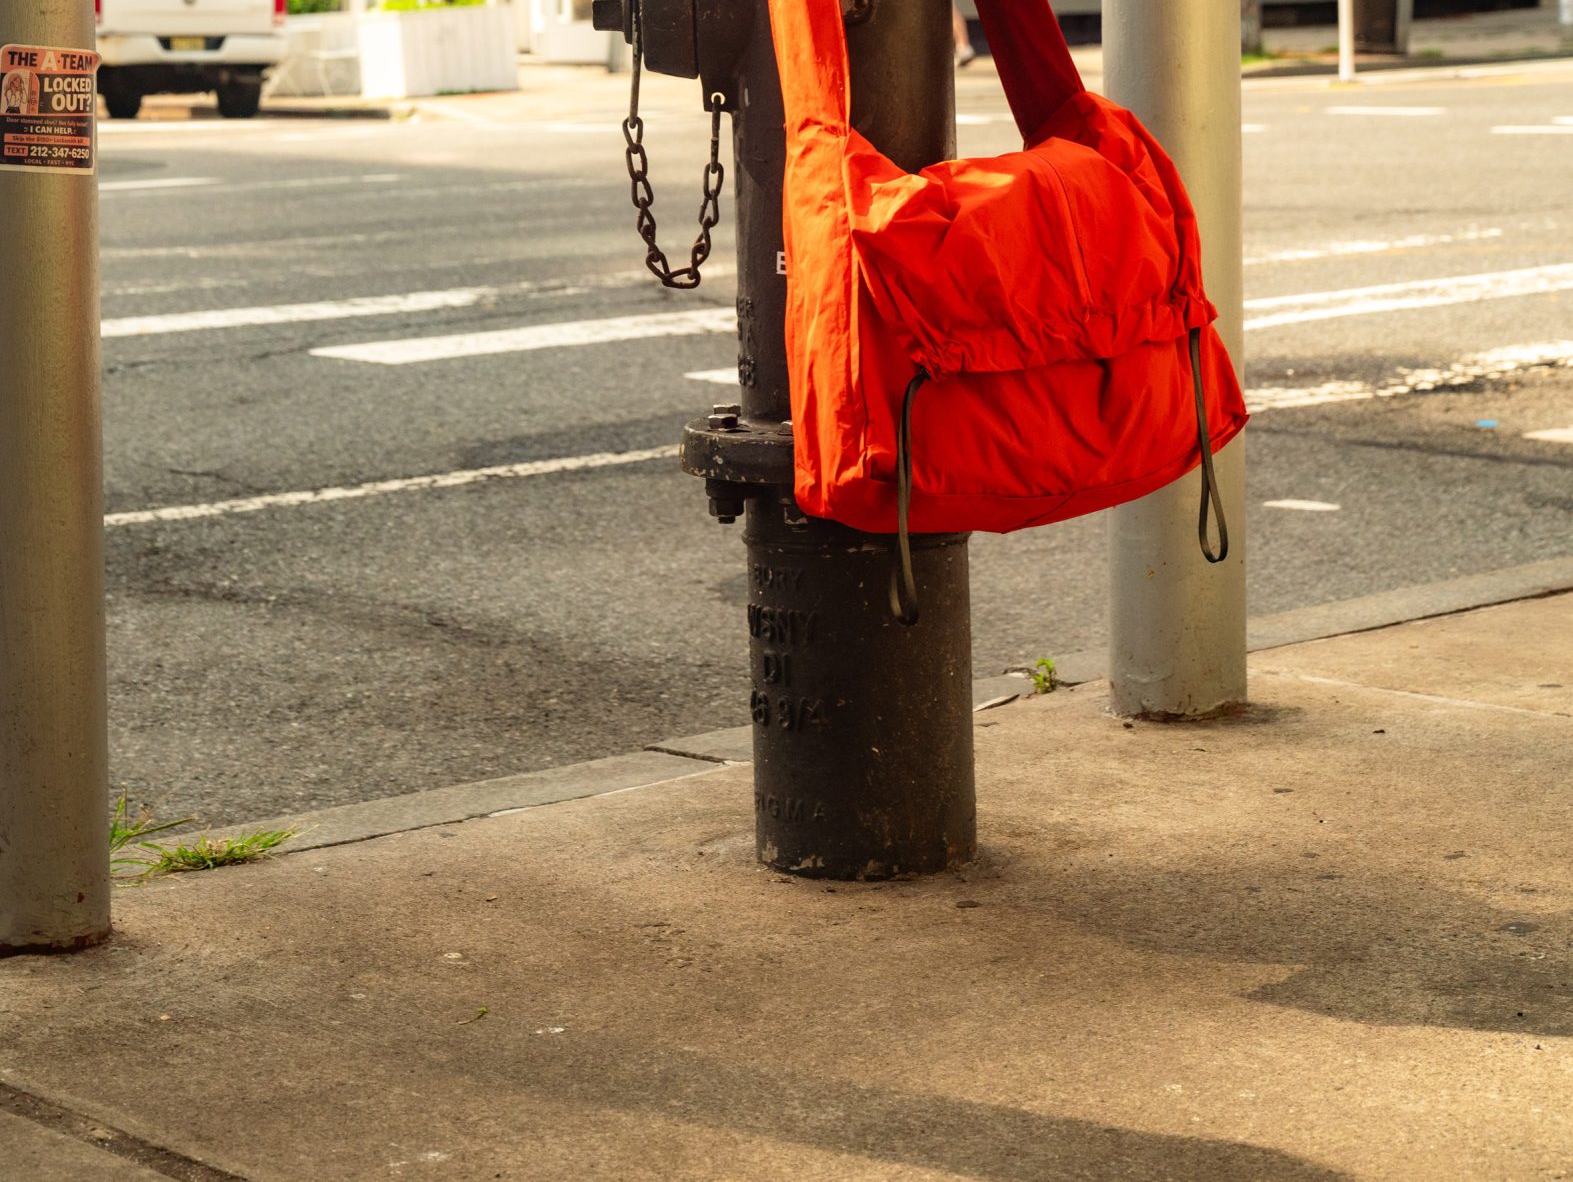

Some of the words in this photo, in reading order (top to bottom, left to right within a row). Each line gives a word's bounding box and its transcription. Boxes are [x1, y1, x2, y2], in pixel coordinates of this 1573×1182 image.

[8, 50, 38, 67] THE
[44, 77, 92, 93] LOCKED
[51, 94, 92, 112] OUT?
[35, 126, 53, 134] CAN
[30, 146, 90, 160] 212-347-6250
